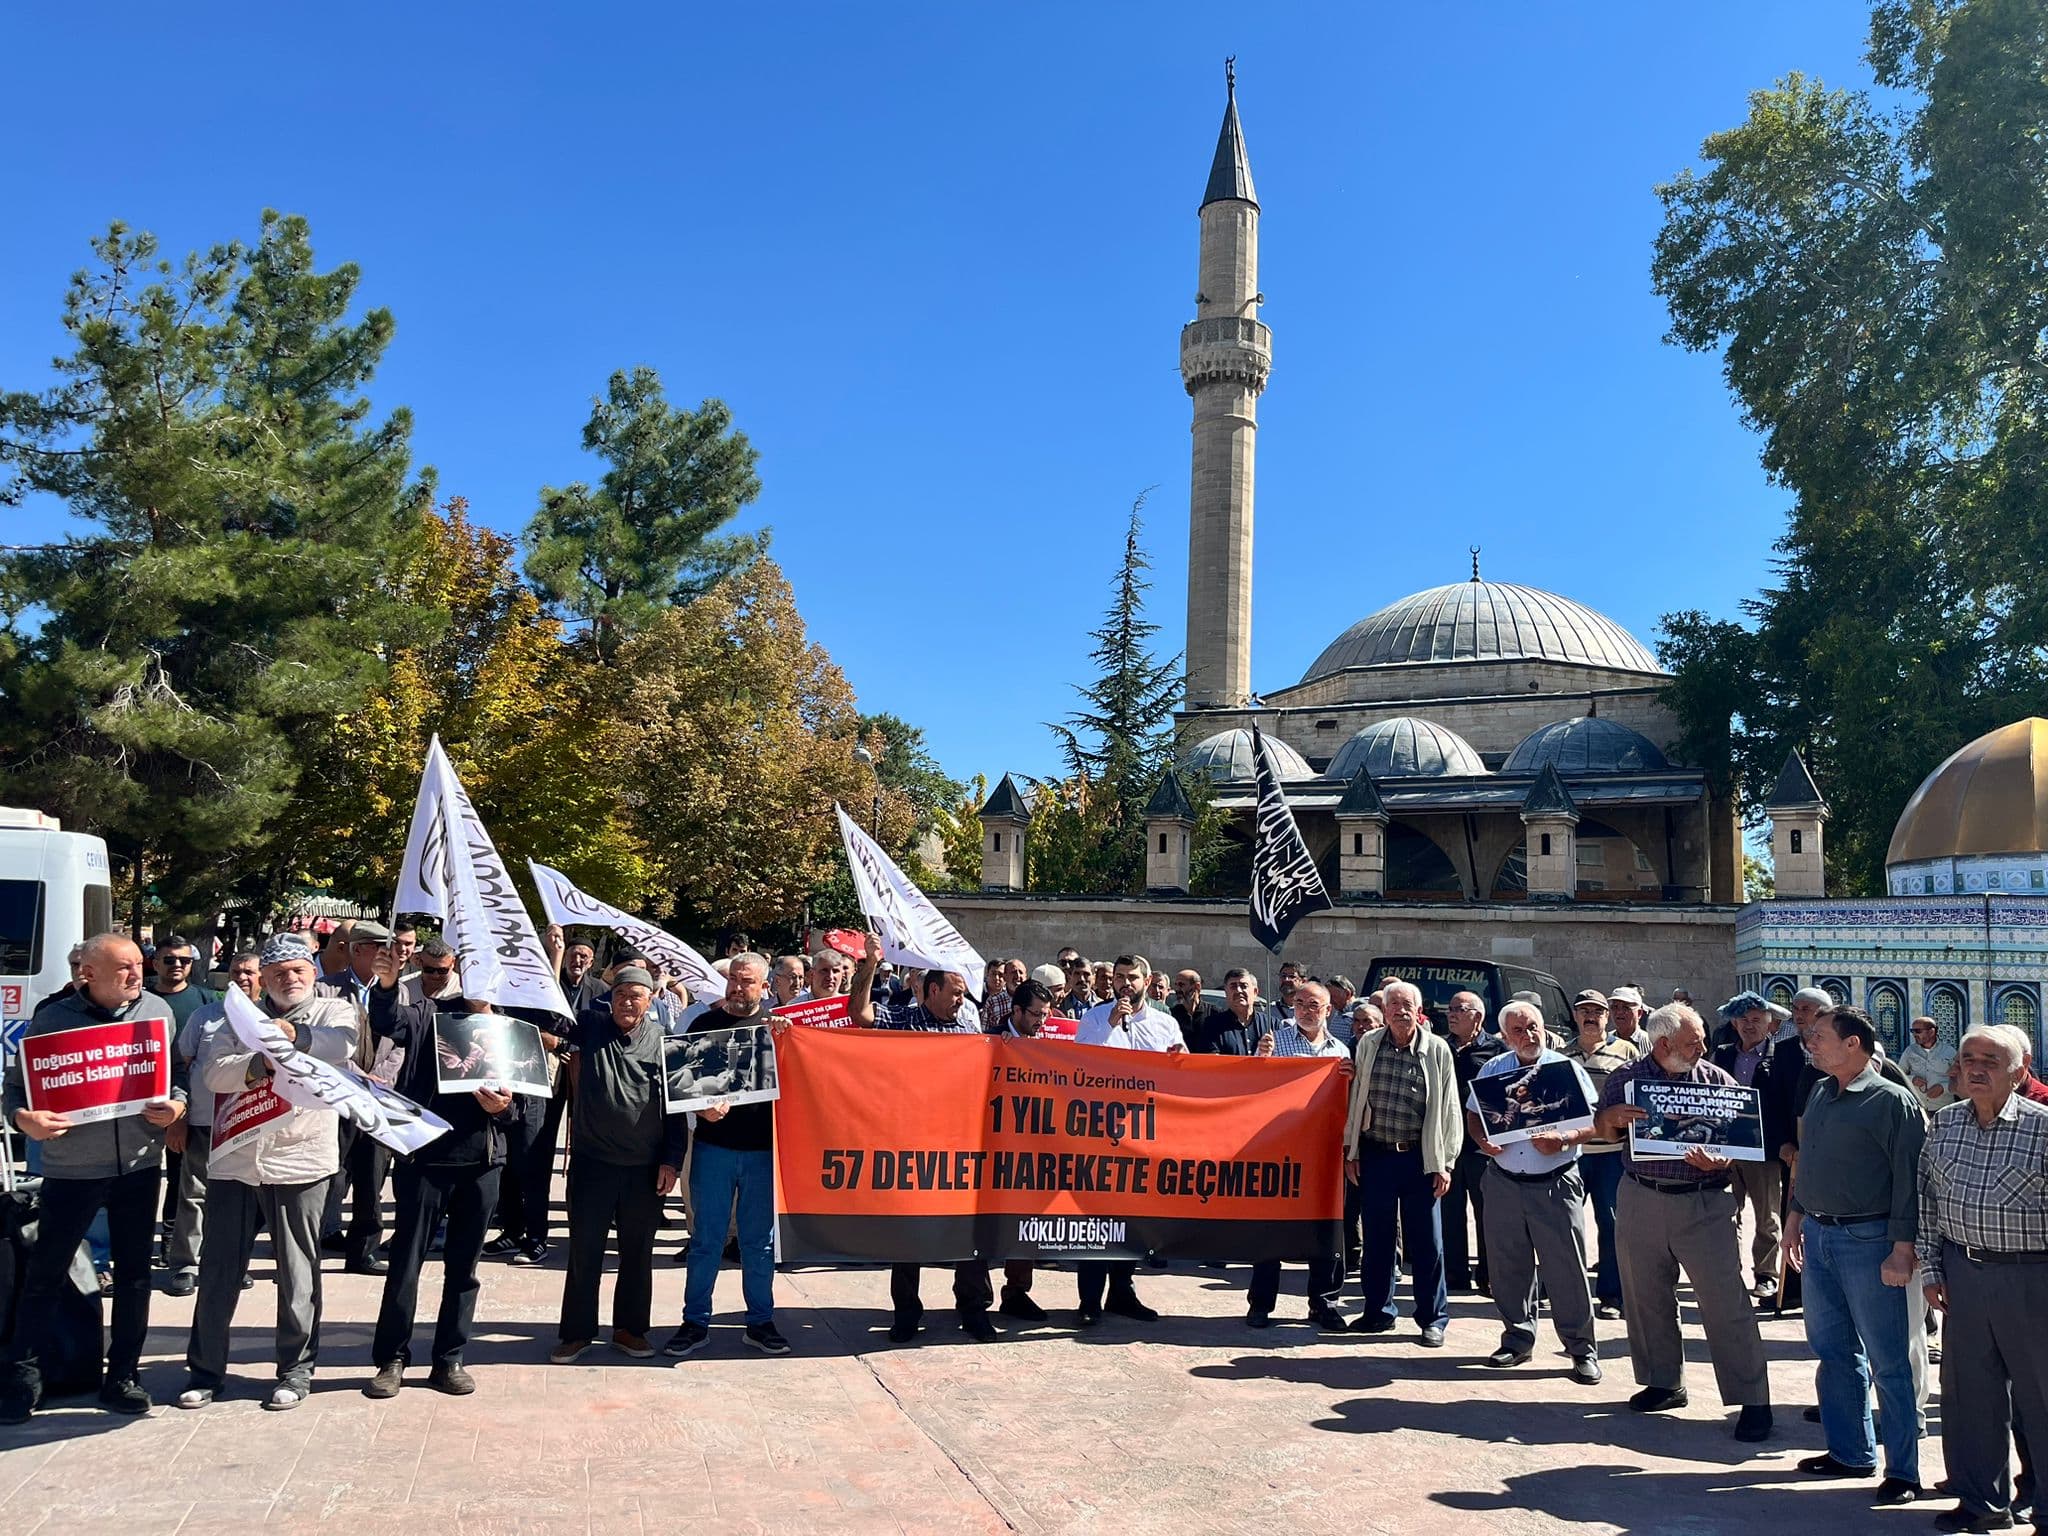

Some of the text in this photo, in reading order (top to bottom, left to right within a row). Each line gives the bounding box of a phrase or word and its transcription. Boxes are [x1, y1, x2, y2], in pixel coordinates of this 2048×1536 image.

[32, 1039, 161, 1071] Doğusu ve Batısı ile
[42, 1070, 84, 1090] Kudüs
[992, 1067, 1156, 1092] 7 Ekim'in Üzerinden
[1641, 1084, 1752, 1101] GASIP YAHUDİ VARLIĞI
[1649, 1093, 1744, 1110] ÇOCUKLARIMIZI
[989, 1095, 1156, 1146] 1 YIL GEÇTİ
[1656, 1104, 1738, 1119] KATLEDİYOR!
[821, 1150, 1302, 1204] 57 DEVLET HAREKETE GEÇMEDİ!
[1018, 1218, 1126, 1245] KÖKLÜ DEĞİŞİM
